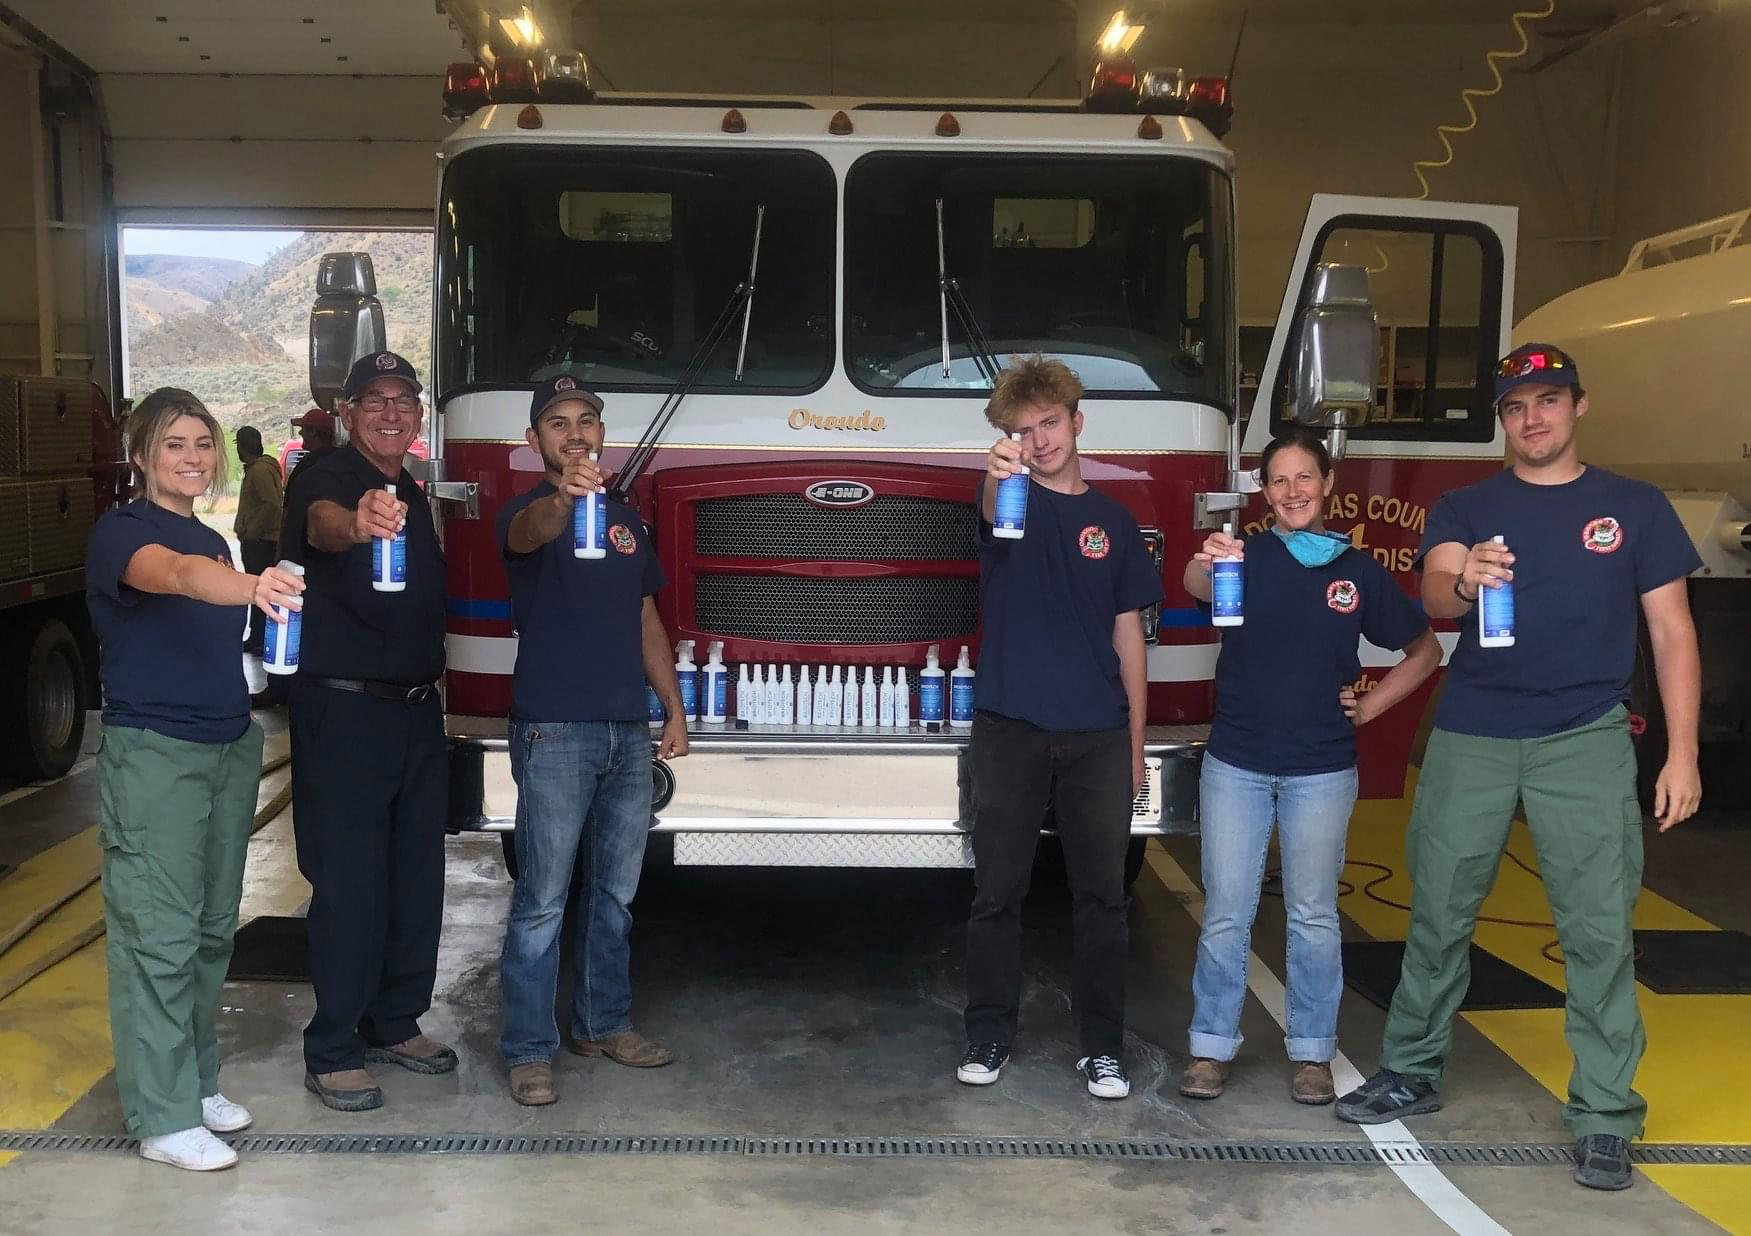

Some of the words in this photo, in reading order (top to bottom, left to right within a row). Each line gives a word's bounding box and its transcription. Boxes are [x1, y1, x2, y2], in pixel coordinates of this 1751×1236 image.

[788, 408, 887, 431] Orondo
[811, 487, 863, 498] E-ONE
[1367, 495, 1425, 535] COUN
[1373, 548, 1418, 572] DIS
